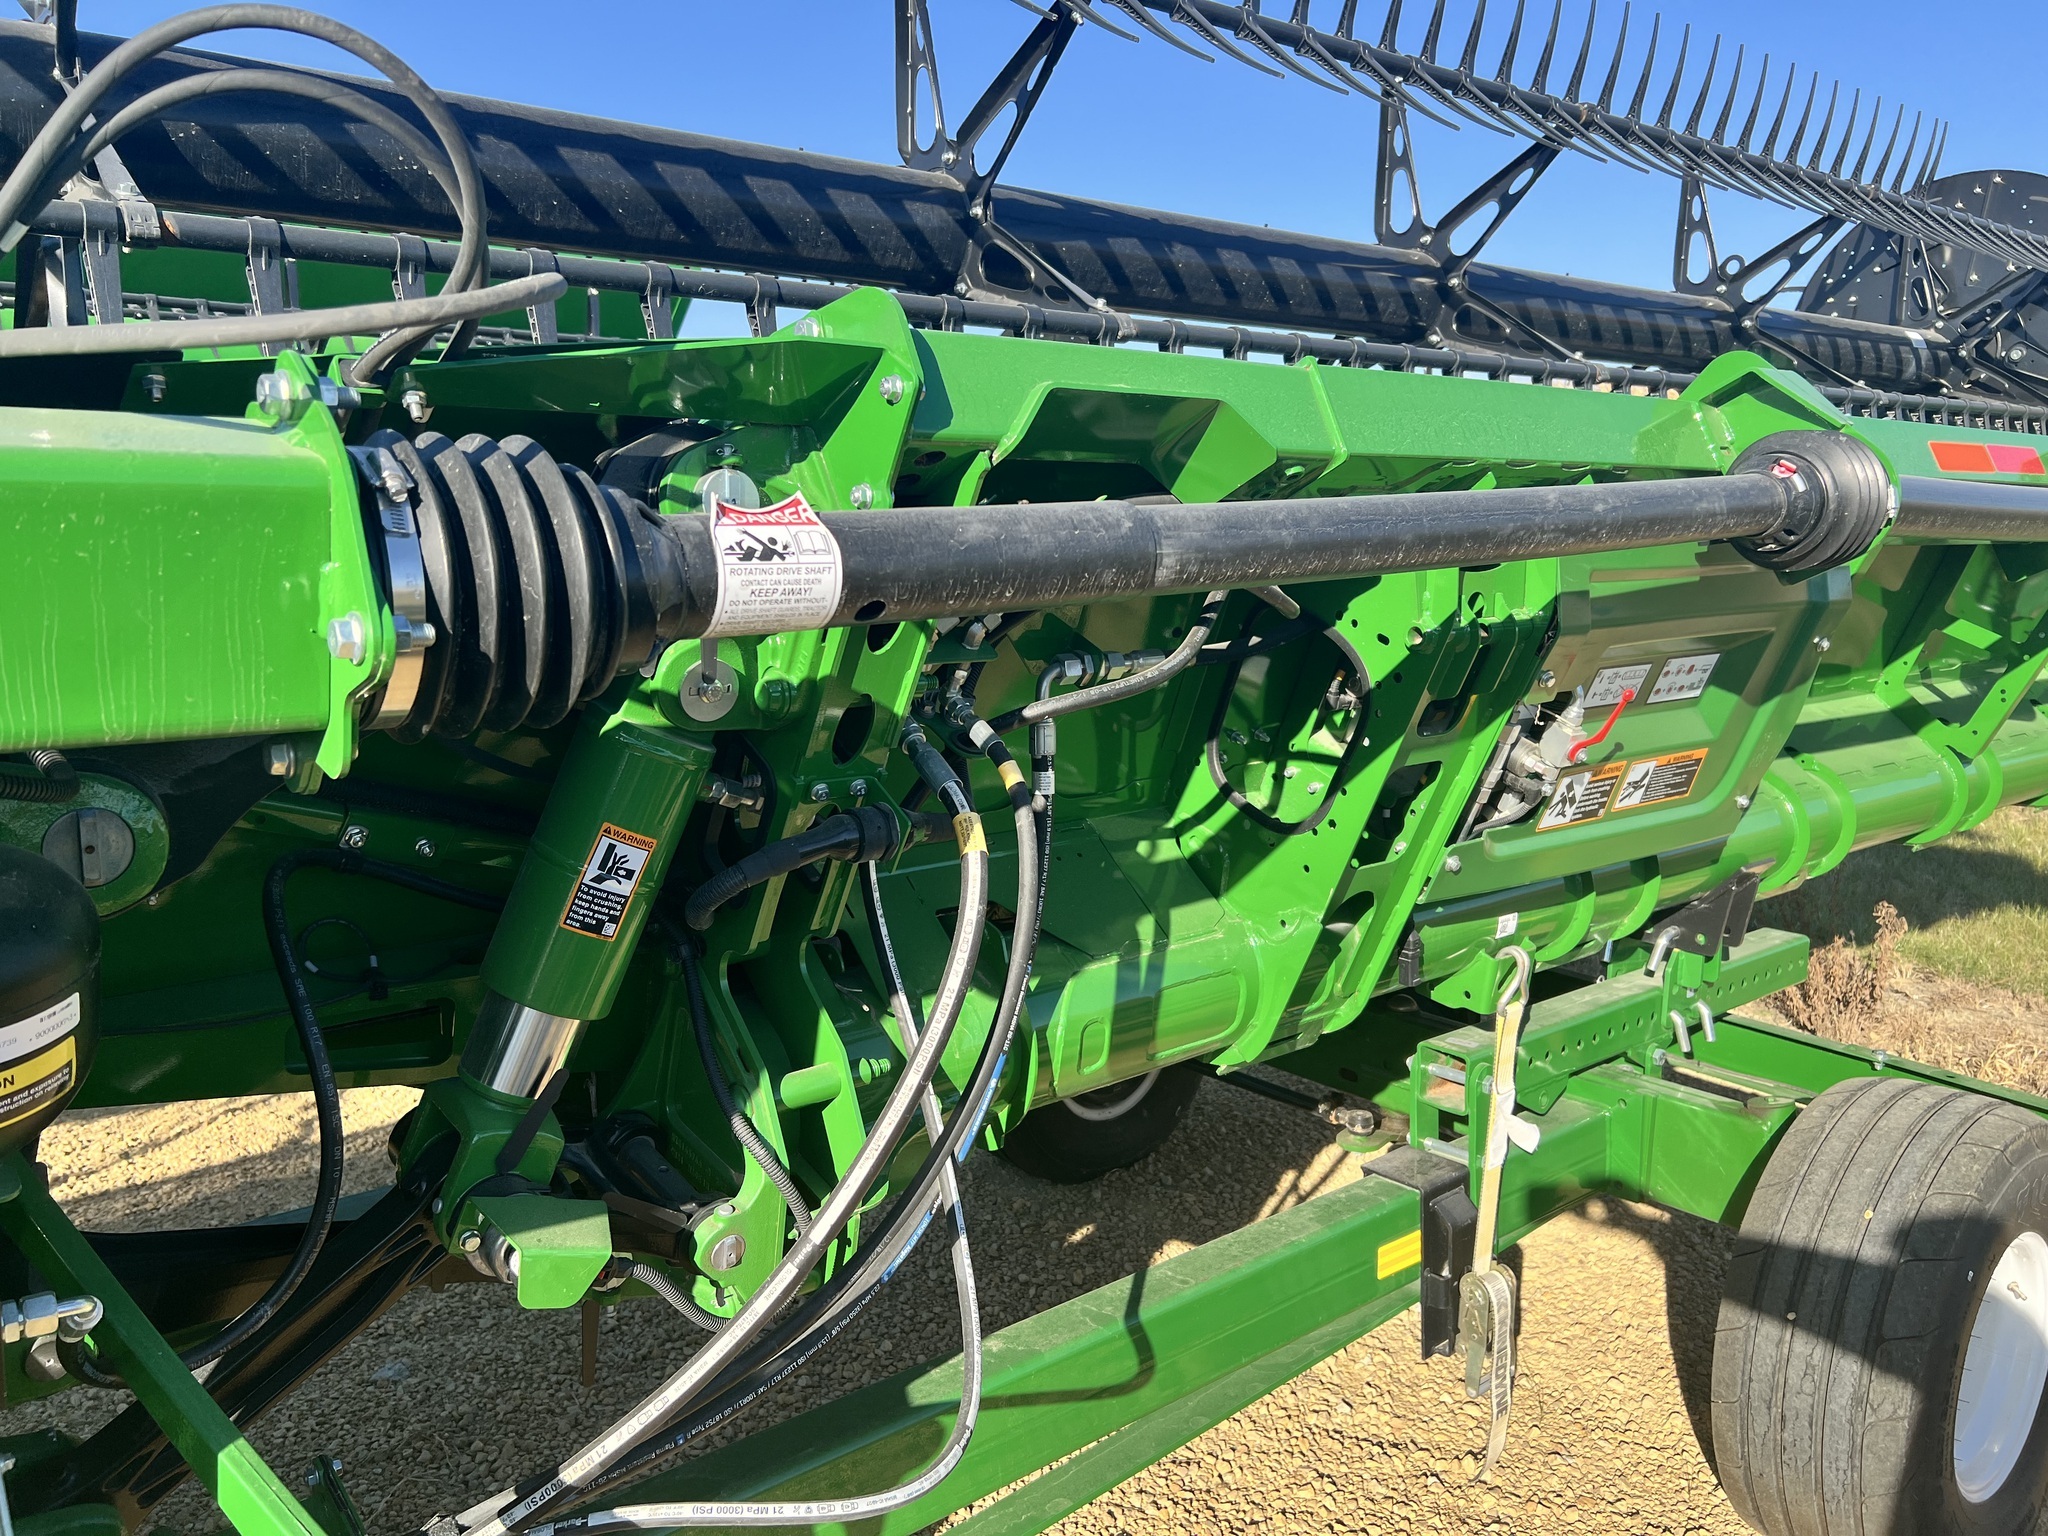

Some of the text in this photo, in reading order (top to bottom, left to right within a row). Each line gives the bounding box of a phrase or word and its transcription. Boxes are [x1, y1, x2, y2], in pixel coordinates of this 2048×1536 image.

[730, 504, 818, 525] DANGER
[730, 566, 832, 576] ROTATING DRIVE SHAFT
[741, 579, 768, 587] CONTACT
[749, 587, 812, 598] KEEP AWAY!
[729, 599, 741, 607] DO
[742, 599, 757, 607] NOT
[759, 598, 793, 606] OPERATE
[613, 829, 656, 849] WARNING
[577, 892, 593, 901] from
[589, 888, 608, 898] avoid
[608, 893, 626, 904] injury
[571, 905, 609, 922] fingers away
[574, 899, 590, 909] keep
[590, 904, 609, 914] hands
[568, 912, 597, 925] from this
[282, 933, 293, 974] exceeds
[943, 986, 955, 999] 21
[302, 1003, 315, 1021] 100
[933, 1001, 950, 1025] MPa
[309, 1026, 323, 1047] R17
[320, 1063, 331, 1077] EN
[13, 1088, 28, 1102] and
[30, 1073, 61, 1094] exposure
[324, 1083, 337, 1102] 857
[333, 1145, 341, 1159] DN
[332, 1166, 340, 1177] 10
[324, 1196, 336, 1222] MSHA
[791, 1242, 812, 1267] Parker
[860, 1292, 872, 1305] MPa
[970, 1297, 978, 1314] MPa
[847, 1302, 863, 1319] (3250
[796, 1354, 807, 1366] ISO
[780, 1360, 798, 1379] 11237
[1484, 1318, 1517, 1420] KINEDYNE
[769, 1373, 782, 1386] R17
[755, 1383, 768, 1396] SAE
[703, 1410, 723, 1429] 18752
[690, 1421, 705, 1437] Type
[593, 1444, 608, 1458] 21
[571, 1454, 595, 1476] MPa
[626, 1448, 655, 1472] Resistant
[692, 1505, 712, 1515] PSI)
[716, 1505, 743, 1514] (3000
[746, 1506, 768, 1514] MPa
[772, 1505, 784, 1515] 21
[554, 1517, 581, 1527] Parker
